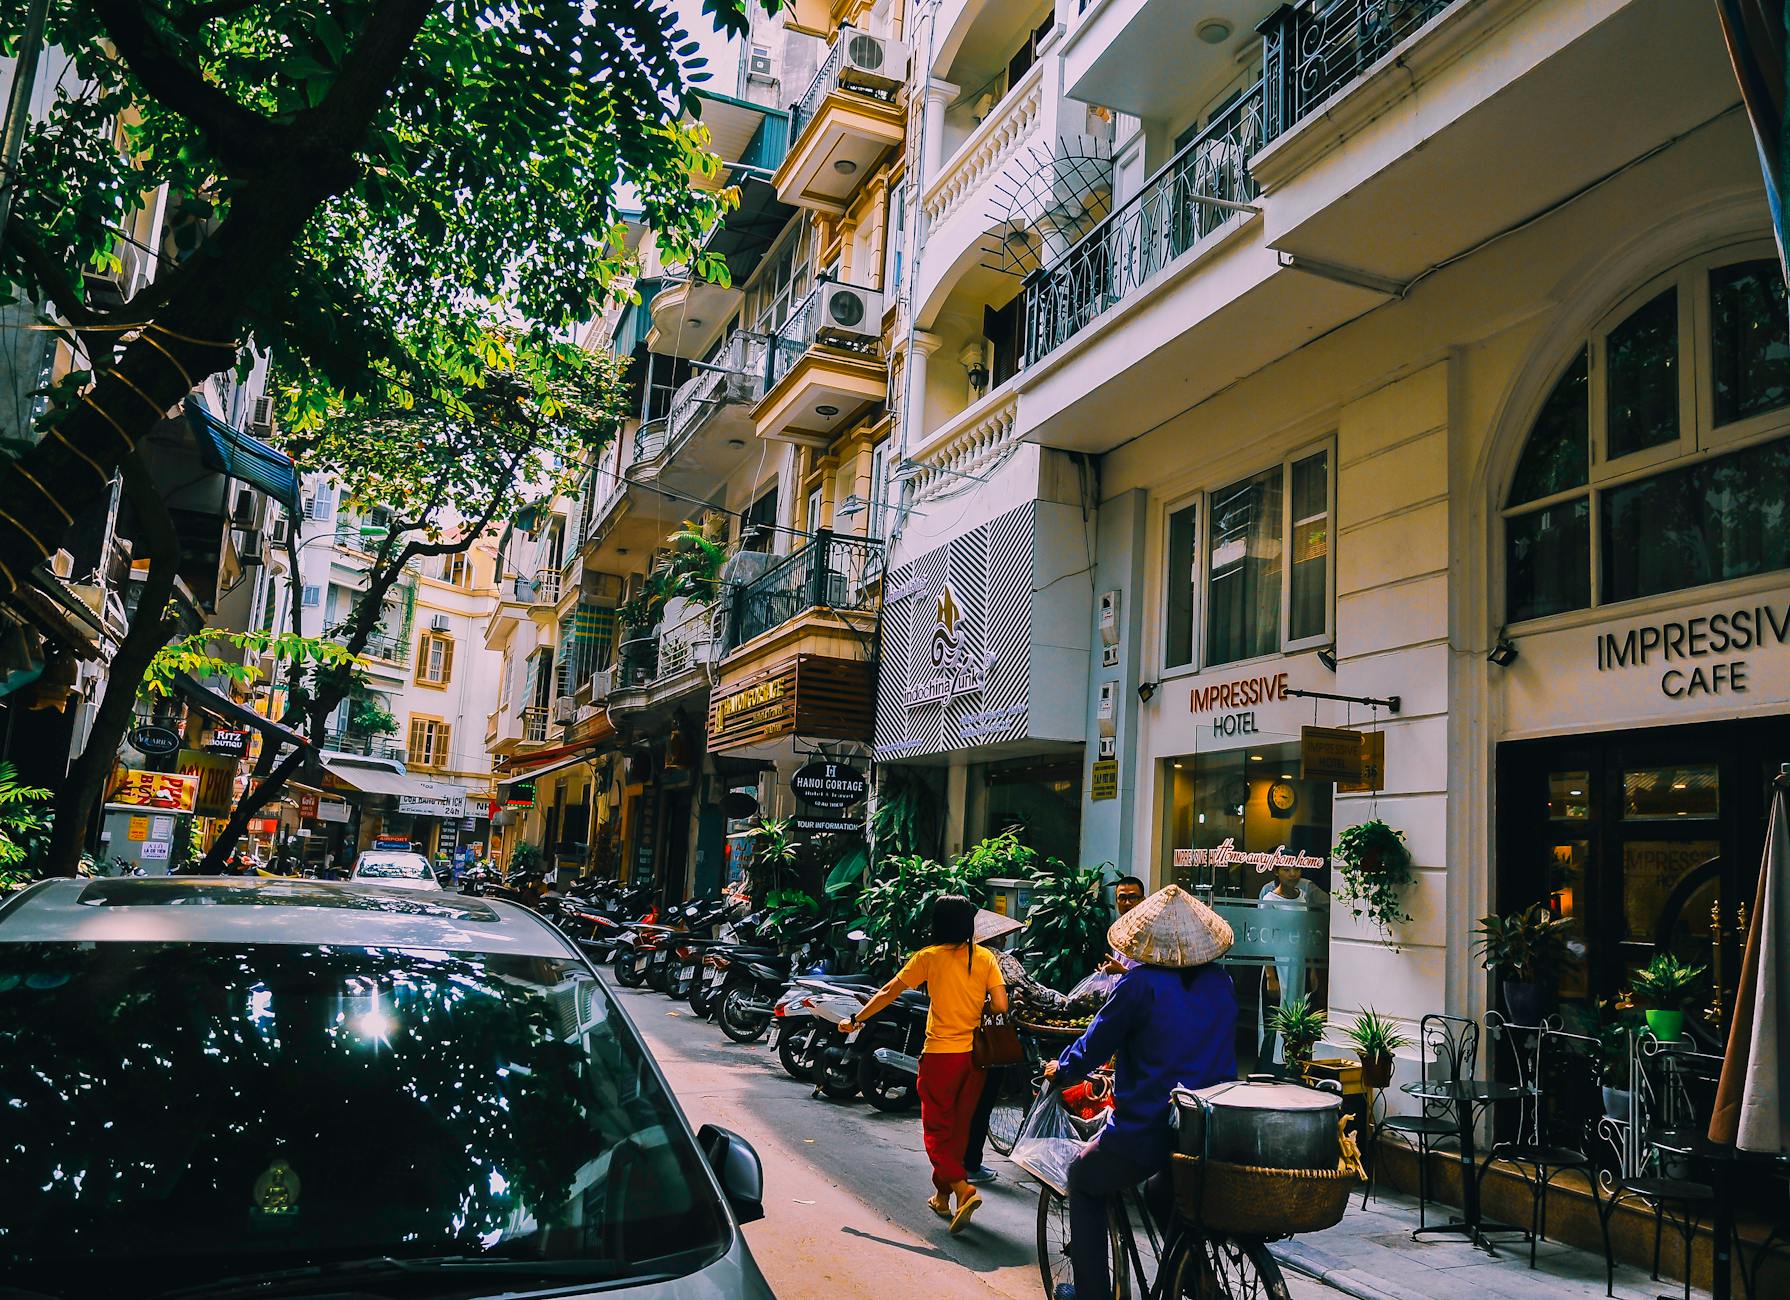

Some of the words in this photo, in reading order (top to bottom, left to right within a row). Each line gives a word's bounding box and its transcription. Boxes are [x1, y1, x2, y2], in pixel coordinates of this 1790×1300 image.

[1597, 604, 1790, 671] IMPRESSIV
[903, 680, 951, 704] indochina
[1189, 671, 1288, 715] IMPRESSIVE
[1661, 660, 1747, 698] CAFE
[216, 730, 242, 741] RITZ
[1212, 711, 1259, 739] HOTEL
[796, 777, 824, 789] HANOI
[825, 779, 864, 792] GORTAGE
[797, 820, 815, 828] TOUR
[815, 821, 859, 831] INFORMATION
[1216, 837, 1247, 866] Home
[1245, 851, 1270, 874] away
[1267, 844, 1297, 872] from
[1295, 849, 1325, 869] home
